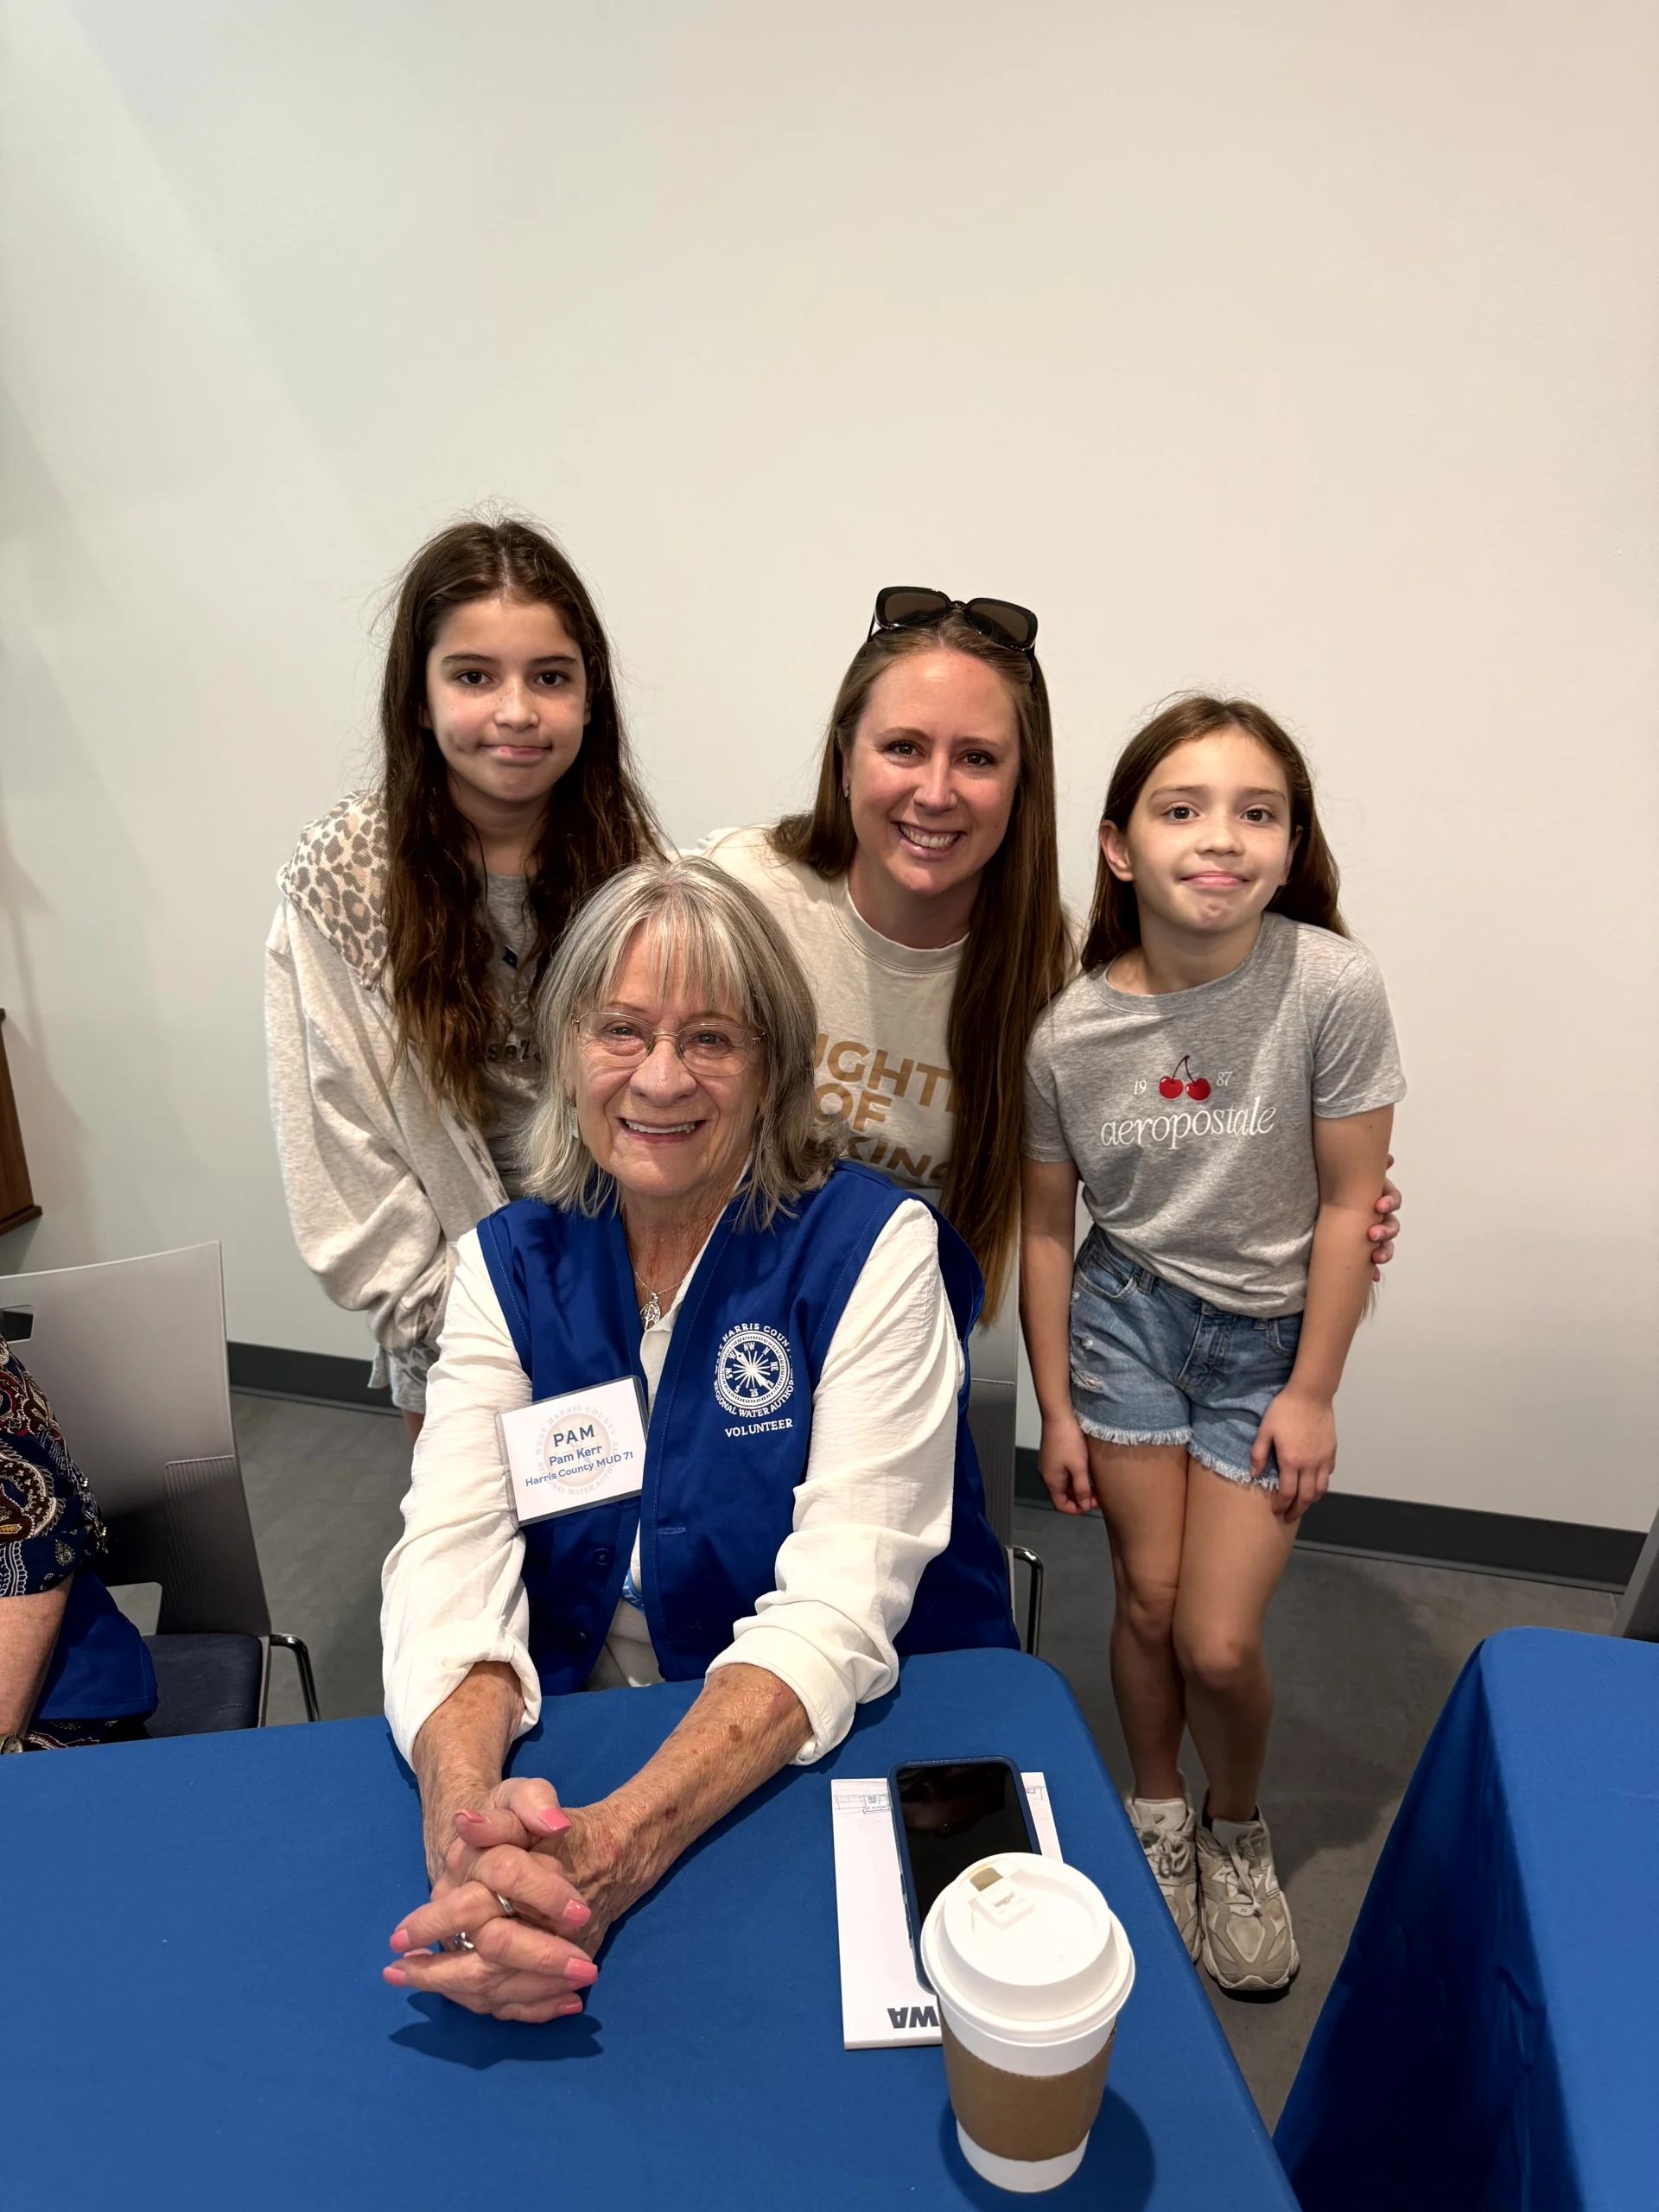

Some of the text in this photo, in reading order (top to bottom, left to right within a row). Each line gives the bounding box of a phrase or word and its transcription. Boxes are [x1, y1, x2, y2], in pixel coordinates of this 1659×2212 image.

[1134, 1080, 1147, 1095] 19
[1217, 1071, 1233, 1086] 87
[815, 1084, 892, 1132] OF
[1100, 1095, 1277, 1149] aeropostale
[721, 1323, 760, 1343] HARRIS
[547, 1405, 582, 1424] HARRIS
[738, 1408, 771, 1418] WATER
[553, 1424, 595, 1447] PAM
[725, 1418, 793, 1438] VOLUNTEER
[549, 1445, 602, 1466] Pam Kerr
[525, 1451, 633, 1486] Harris County MUD 71
